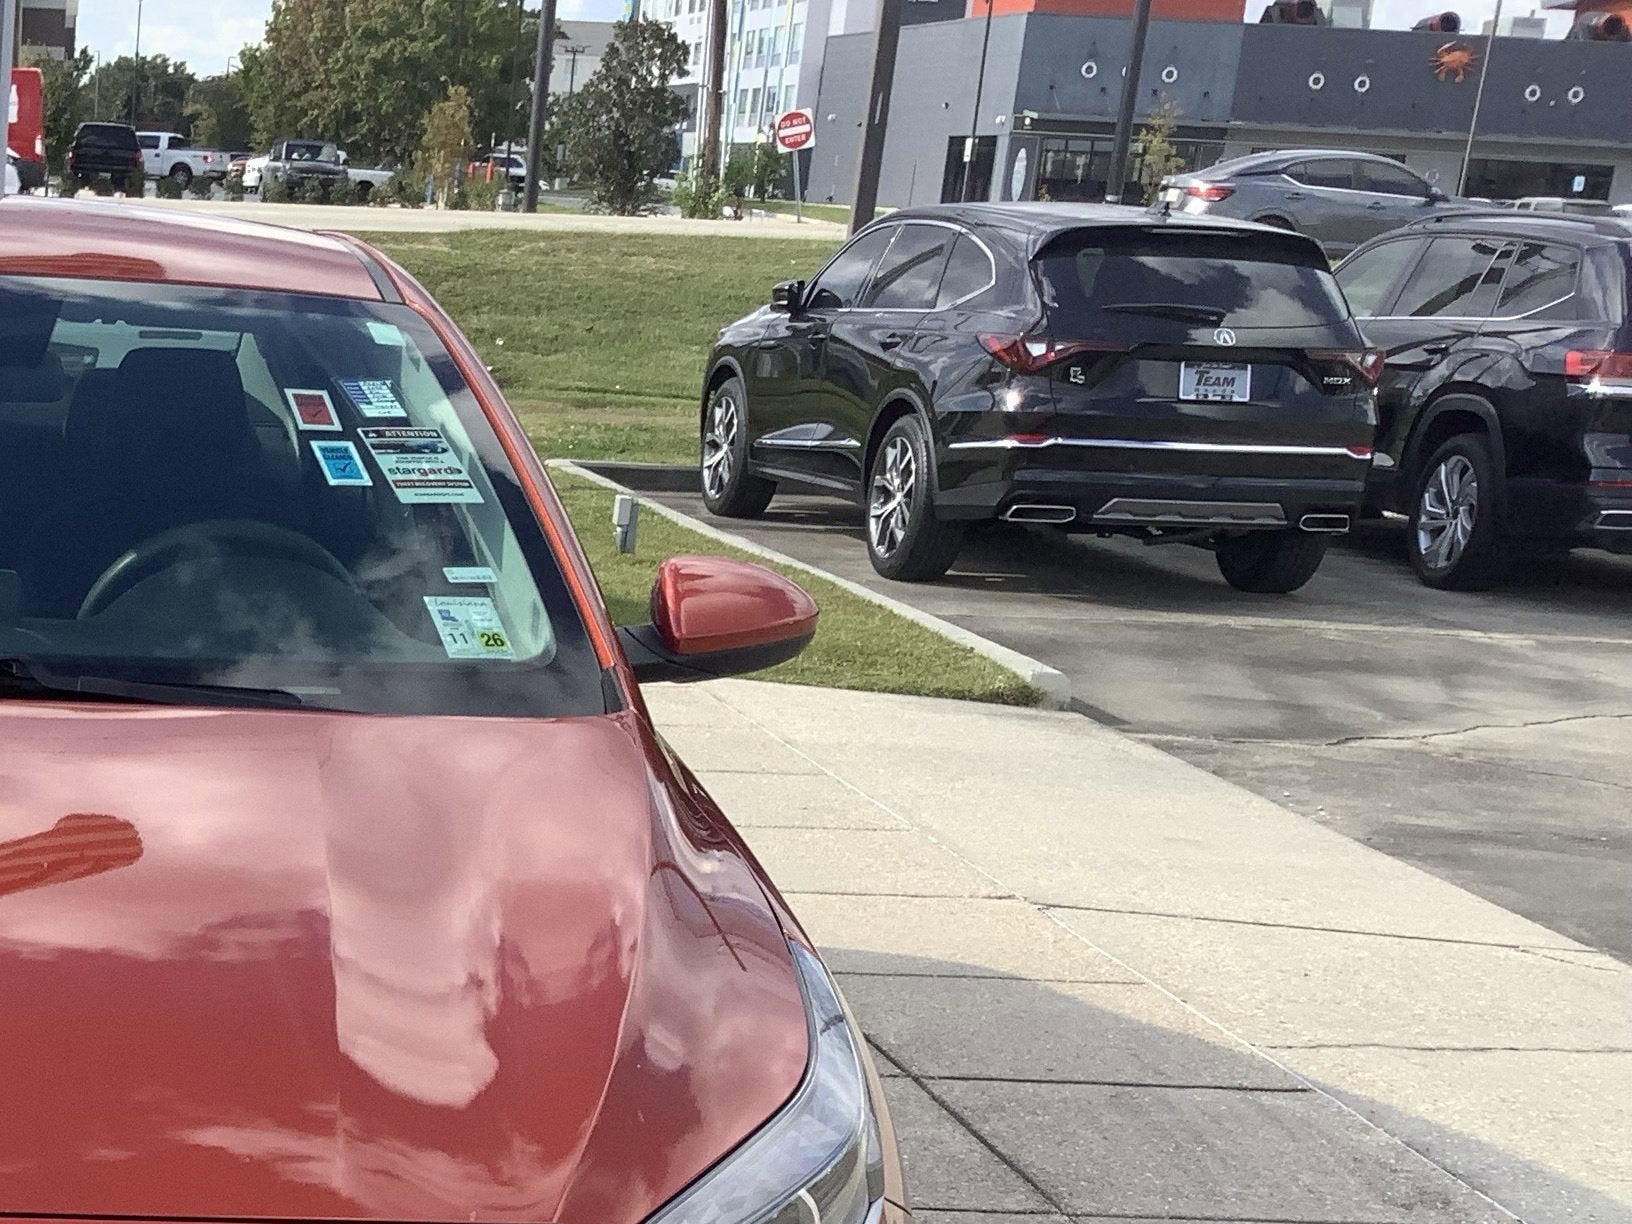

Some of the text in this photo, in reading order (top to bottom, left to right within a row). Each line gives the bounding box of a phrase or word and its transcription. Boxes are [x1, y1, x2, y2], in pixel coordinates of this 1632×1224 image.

[780, 116, 806, 128] DO NOT
[785, 133, 806, 144] ENTER
[1323, 377, 1352, 385] MDX
[448, 632, 505, 647] 11 26
